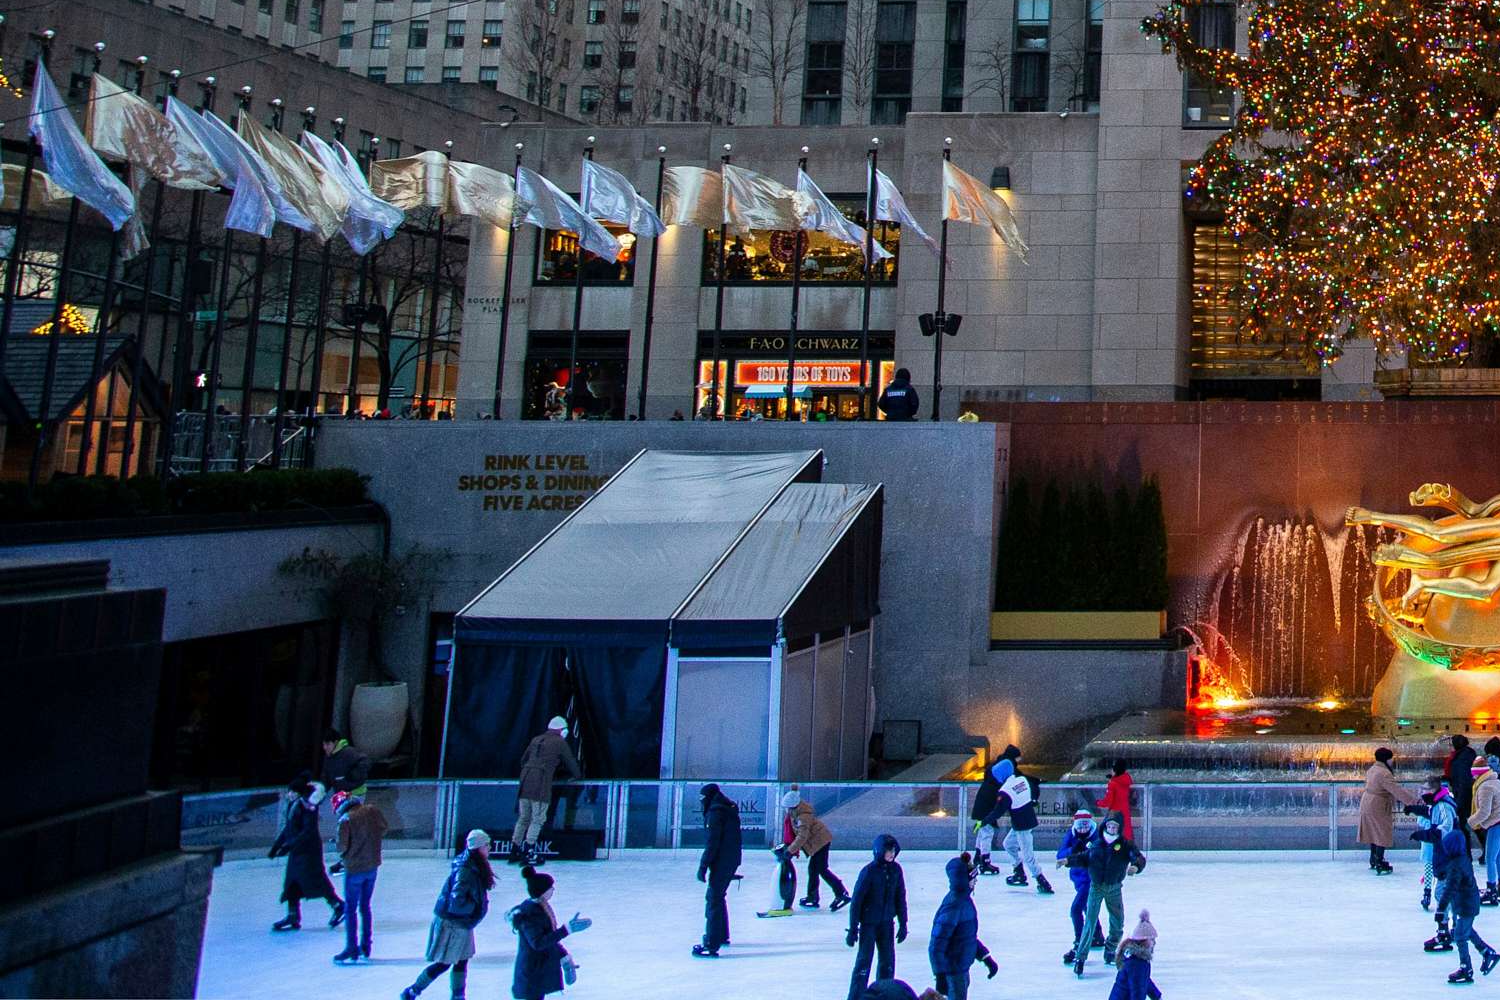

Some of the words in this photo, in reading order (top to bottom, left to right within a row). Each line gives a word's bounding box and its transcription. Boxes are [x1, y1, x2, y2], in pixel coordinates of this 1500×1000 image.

[794, 337, 859, 350] CHWARZ
[757, 367, 776, 382] 160
[811, 367, 824, 382] OF
[825, 367, 851, 382] TOYS
[484, 455, 532, 471] RINK
[536, 455, 589, 471] LEVEL
[458, 475, 522, 491] SHOPS
[525, 475, 540, 490] &
[483, 495, 524, 511] FIVE
[526, 495, 585, 511] ACRES
